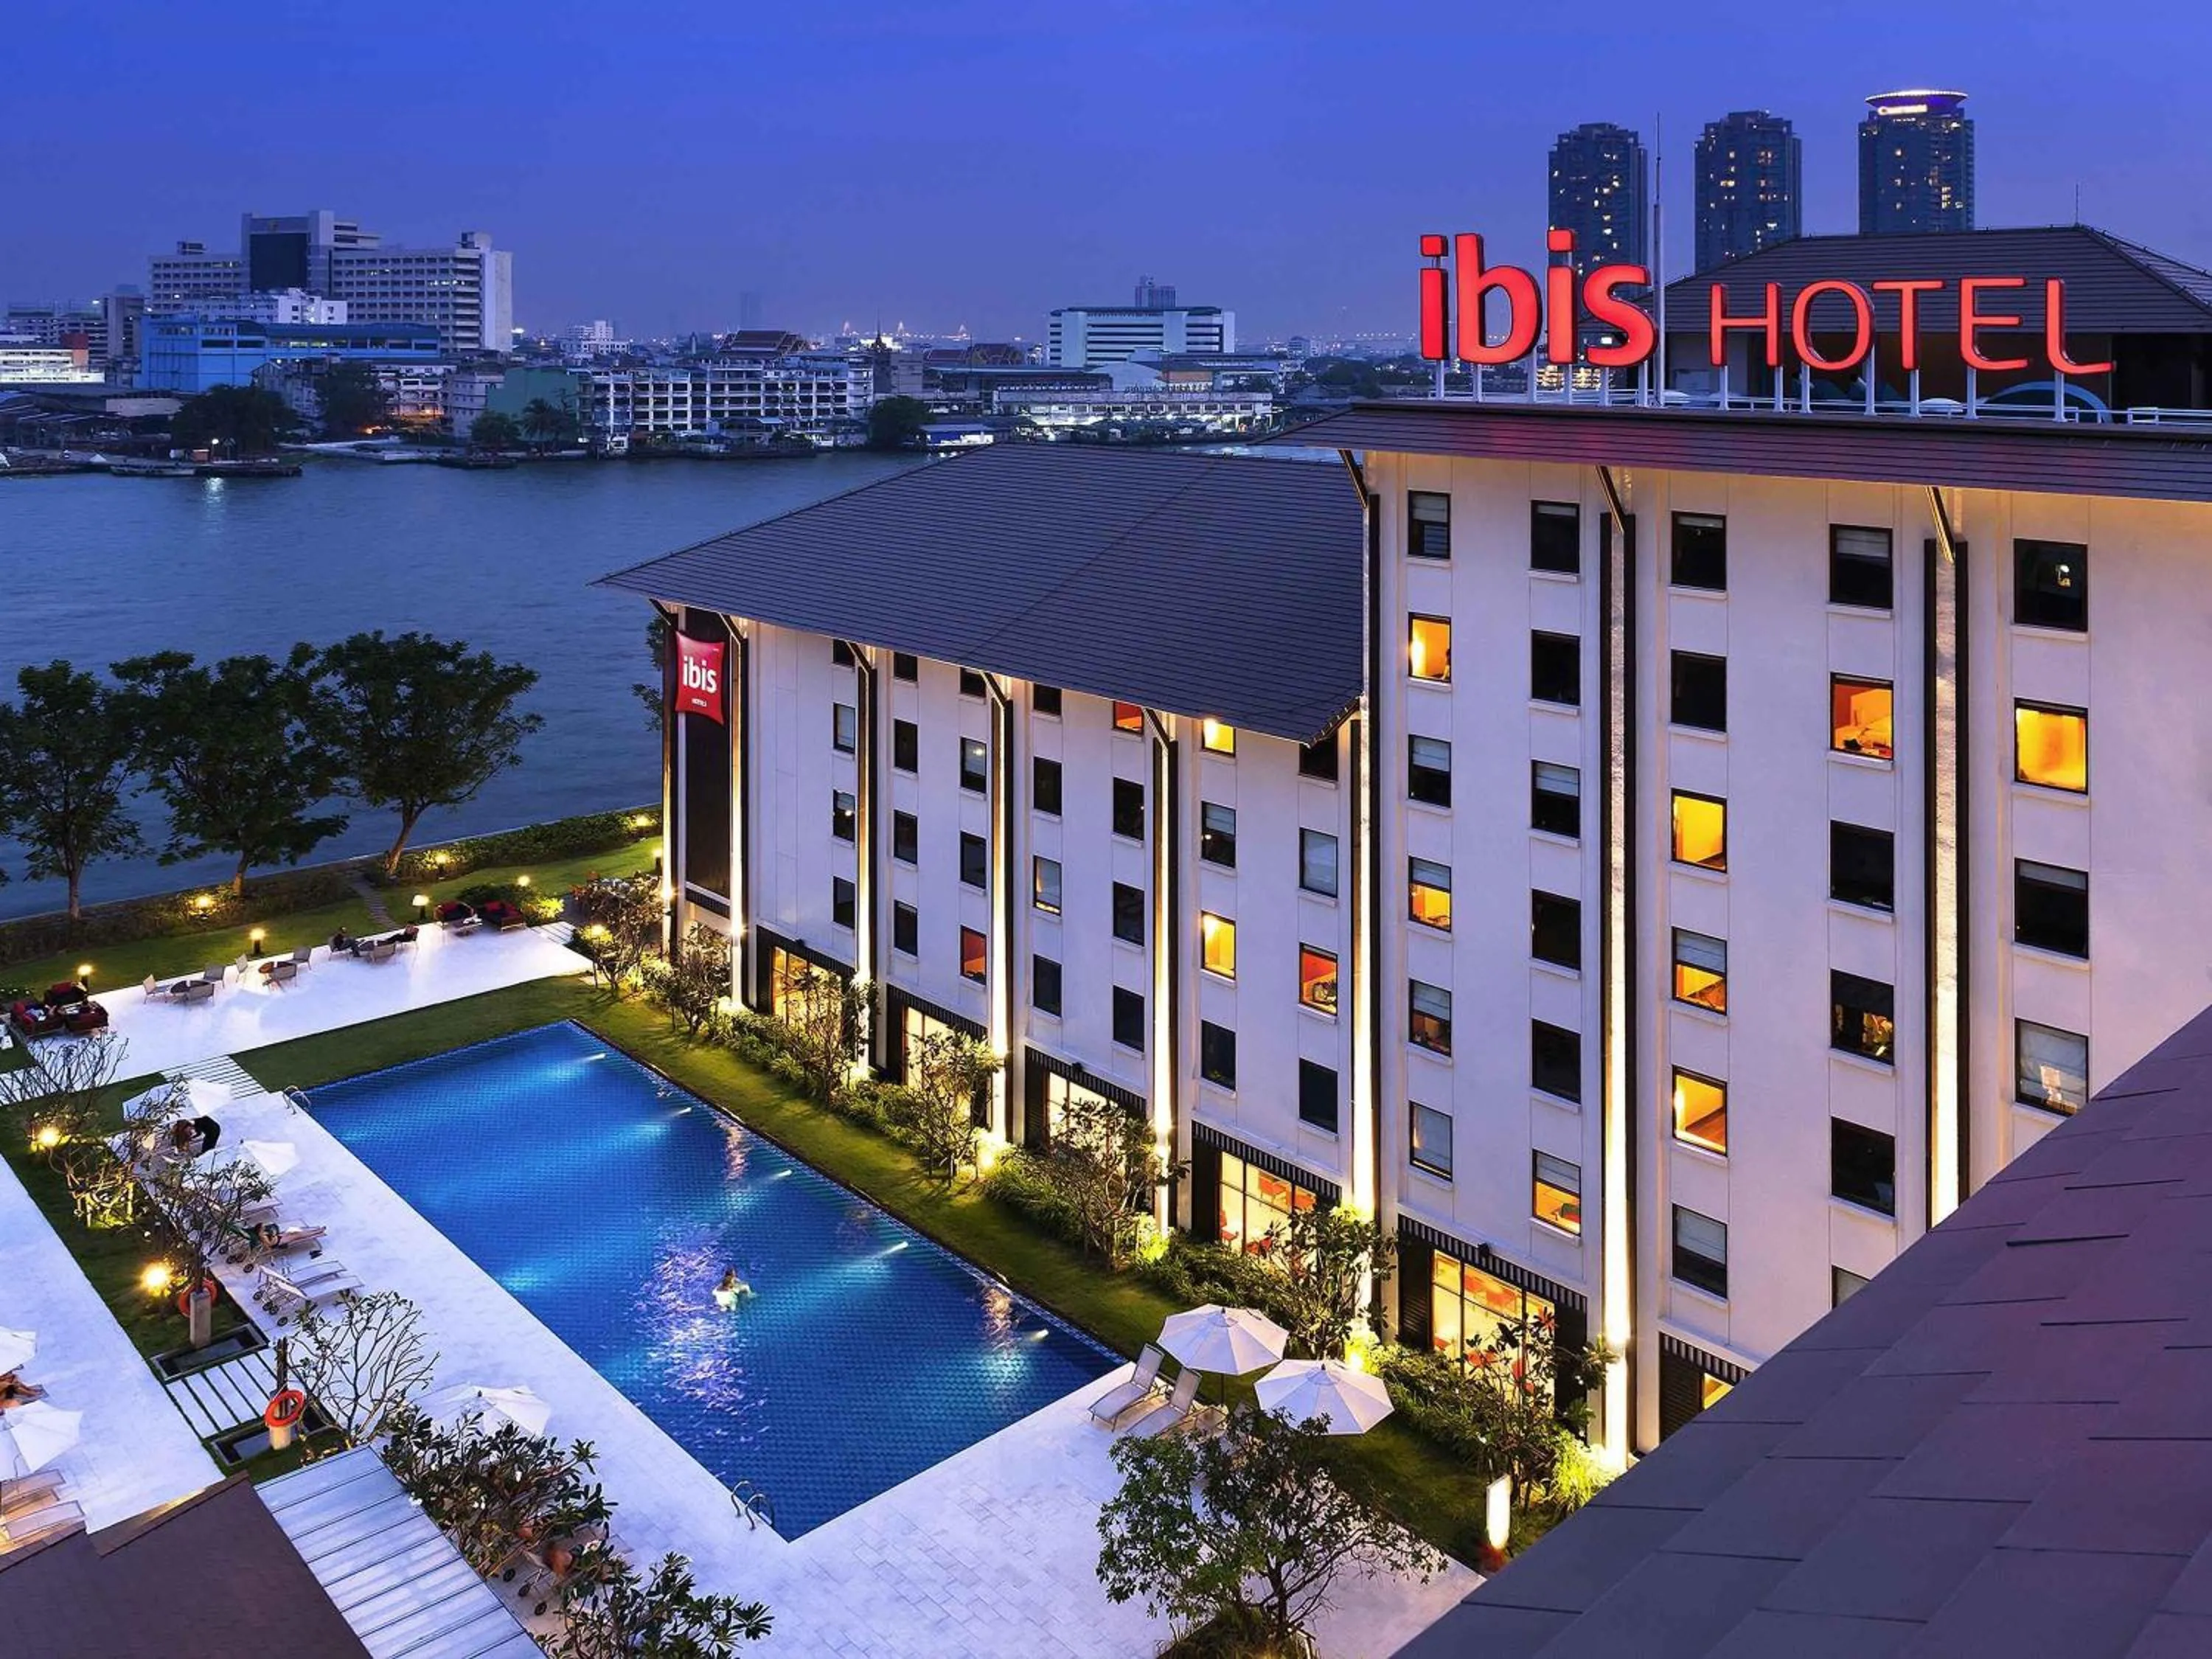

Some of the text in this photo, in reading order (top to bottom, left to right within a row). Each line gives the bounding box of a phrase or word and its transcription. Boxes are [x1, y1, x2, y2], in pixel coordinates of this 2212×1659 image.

[1420, 229, 2114, 374] ibis HOTEL
[683, 655, 717, 694] ibis
